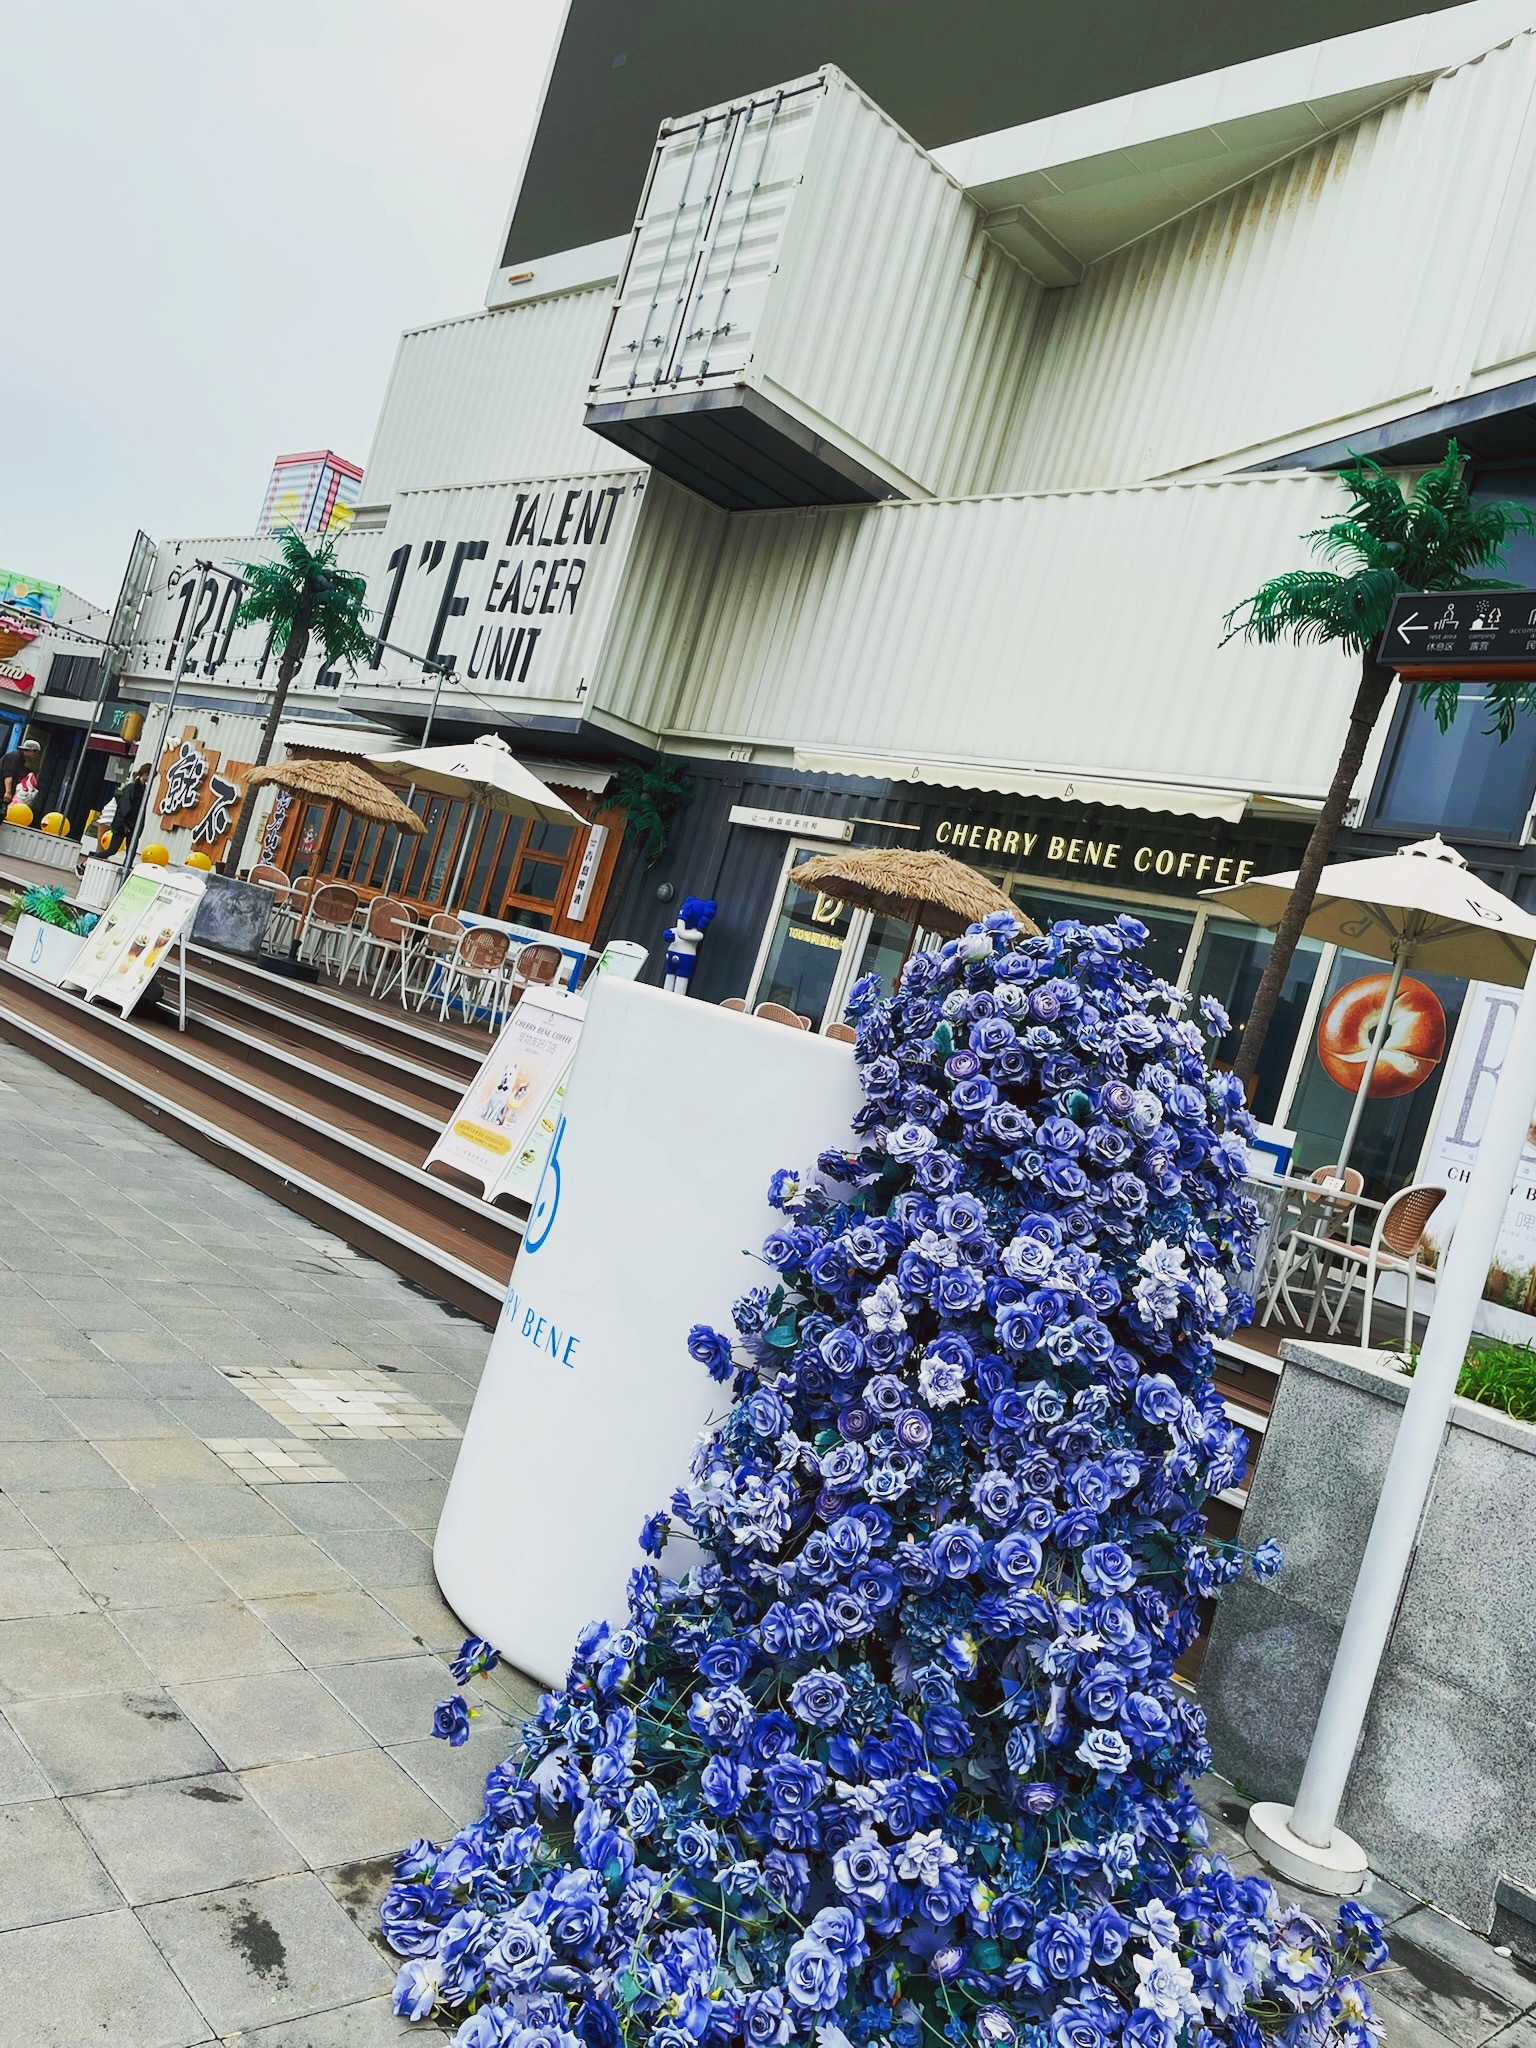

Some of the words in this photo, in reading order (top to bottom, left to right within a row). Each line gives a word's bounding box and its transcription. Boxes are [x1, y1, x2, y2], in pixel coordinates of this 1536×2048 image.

[506, 486, 625, 546] TALENT
[485, 559, 586, 615] EAGER
[467, 625, 542, 683] UNIT
[1426, 641, 1455, 651] 休息区
[935, 821, 1039, 857] CHERRY
[1047, 835, 1122, 869] BENE
[1134, 846, 1255, 886] COFFEE
[515, 1019, 537, 1032] CHERRY
[537, 1026, 552, 1037] BENE
[552, 1032, 573, 1044] COFFEE
[521, 1307, 581, 1369] BENE
